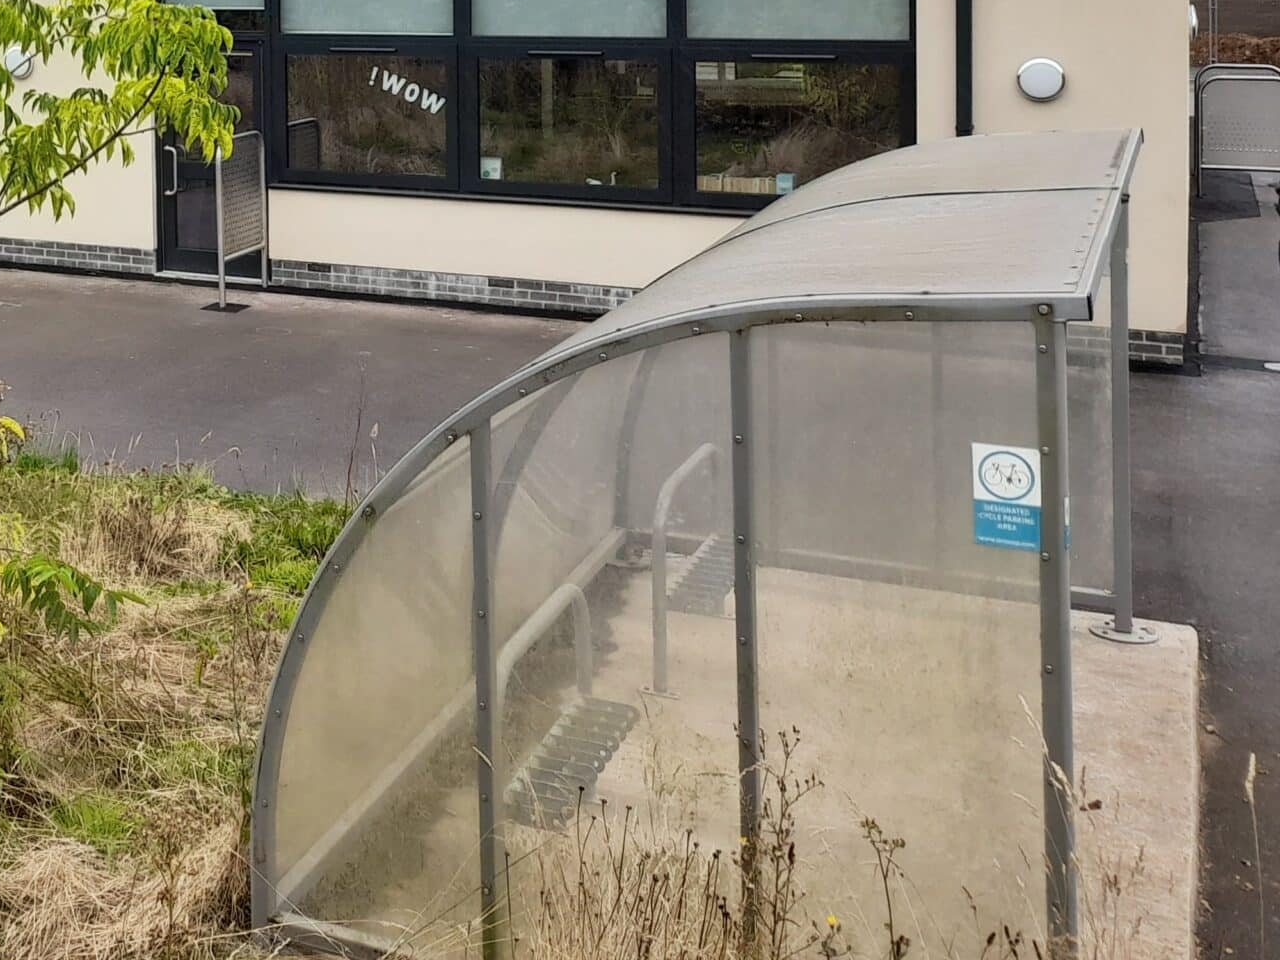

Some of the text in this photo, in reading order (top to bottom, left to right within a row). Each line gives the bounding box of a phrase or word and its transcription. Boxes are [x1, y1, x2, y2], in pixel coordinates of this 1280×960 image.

[983, 503, 1030, 516] DESIGNATED
[978, 511, 1035, 526] CYCLE PARKING
[997, 522, 1017, 531] AREA
